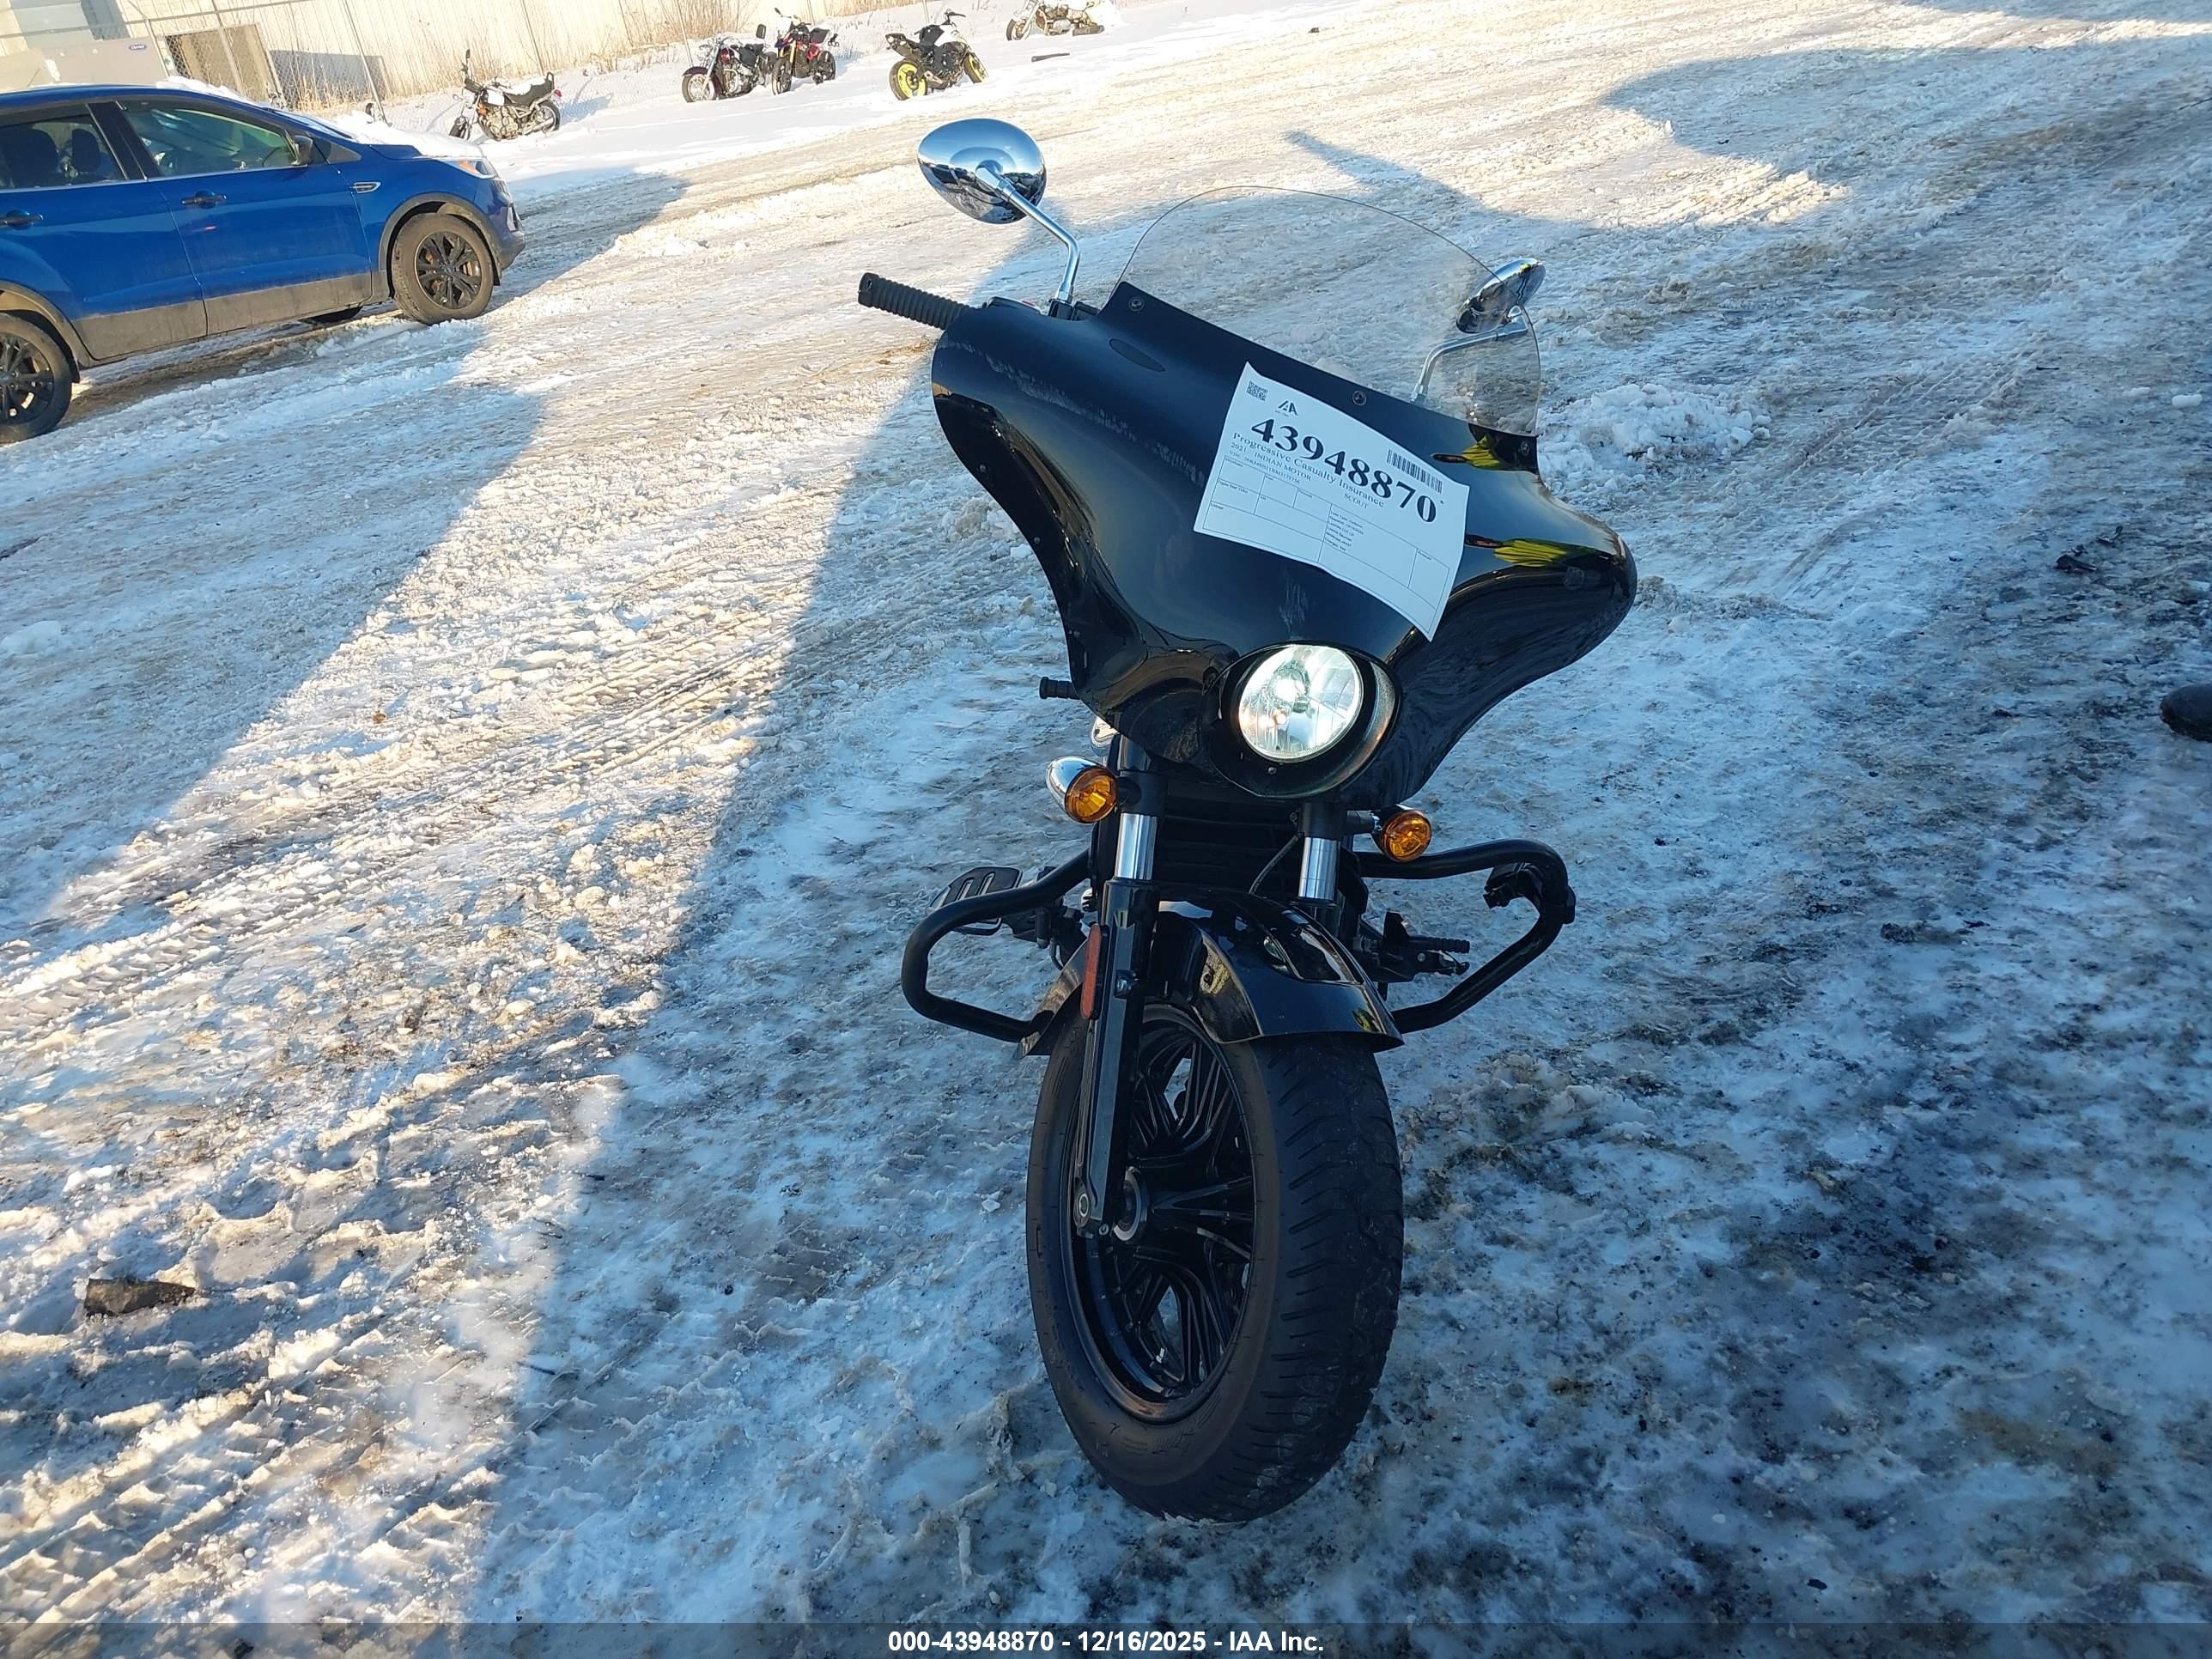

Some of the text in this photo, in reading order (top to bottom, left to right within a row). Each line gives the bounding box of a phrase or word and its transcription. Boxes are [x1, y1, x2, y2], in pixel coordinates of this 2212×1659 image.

[1231, 442, 1247, 453] 2021
[1255, 452, 1283, 468] INDIAN
[1284, 465, 1311, 481] MOTOR
[1345, 492, 1368, 509] SCOUT
[1233, 432, 1291, 462] Progressive
[1294, 459, 1337, 483] Casualty
[1339, 479, 1384, 507] Insurance
[1251, 419, 1437, 523] 43948870
